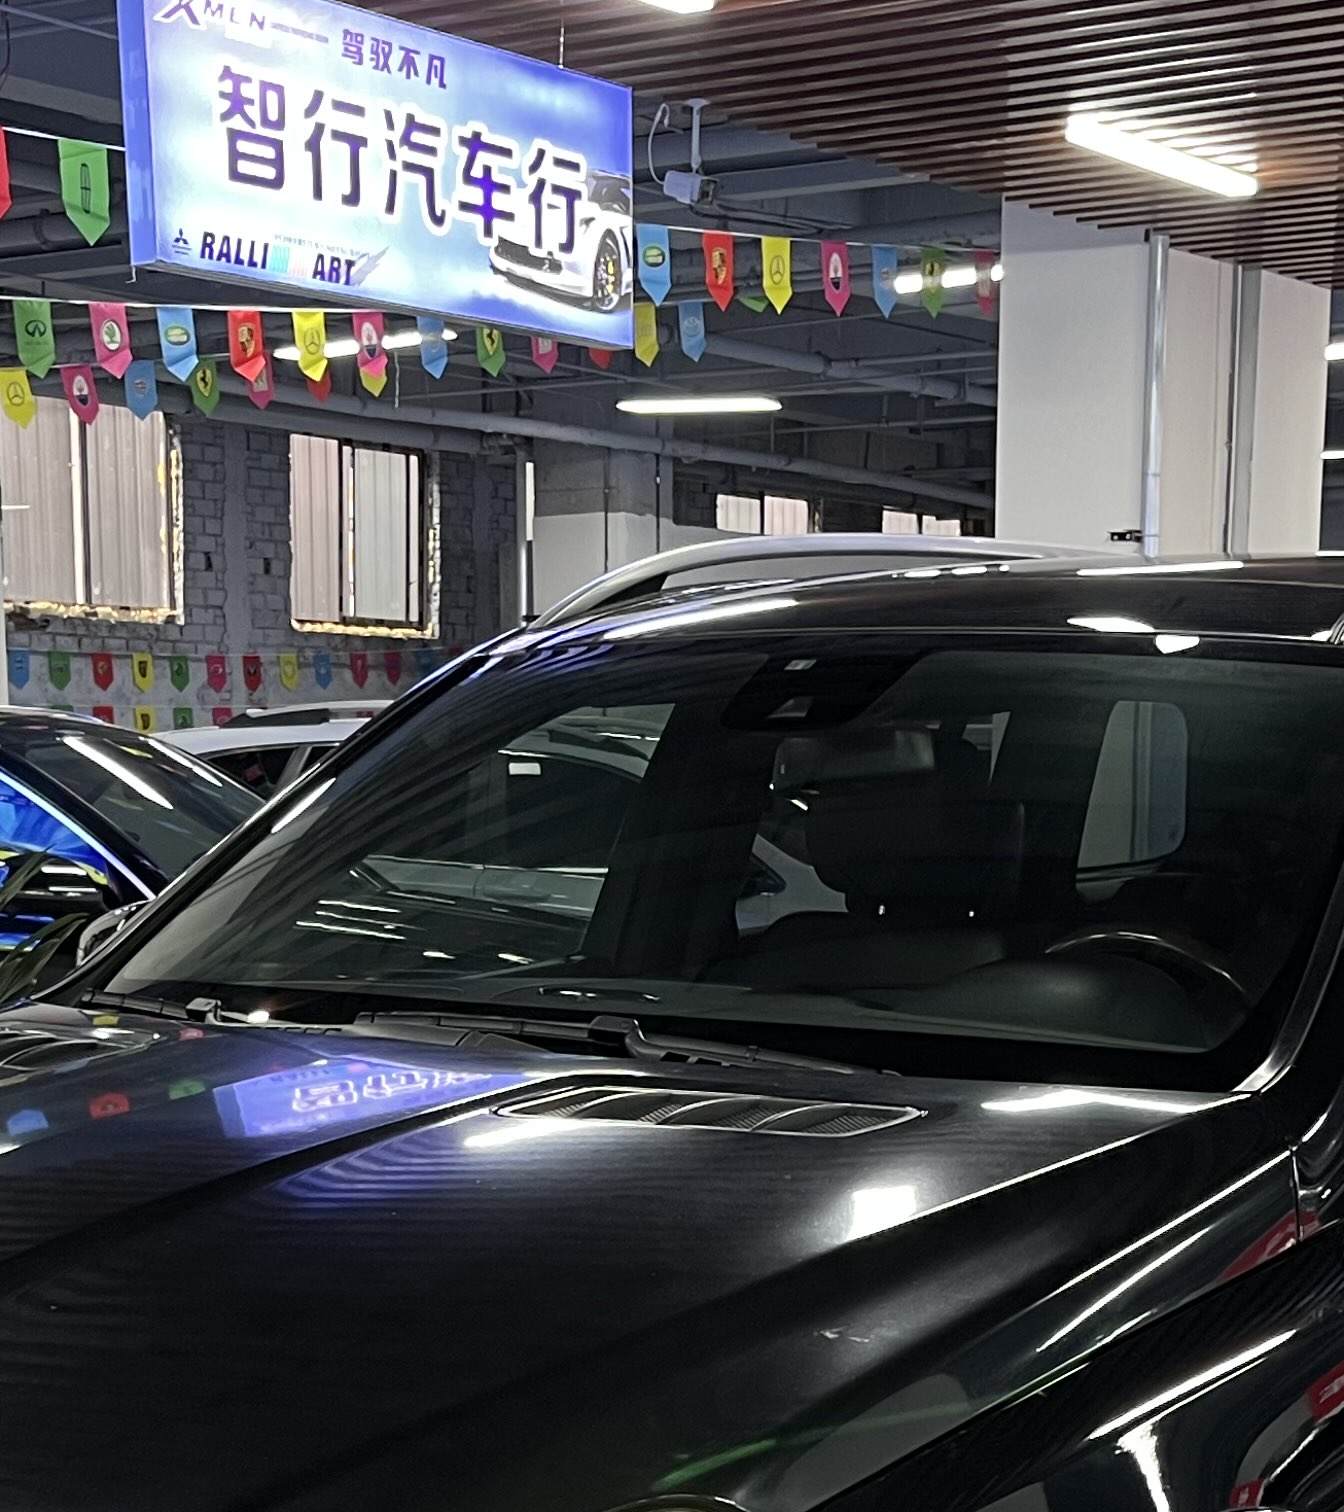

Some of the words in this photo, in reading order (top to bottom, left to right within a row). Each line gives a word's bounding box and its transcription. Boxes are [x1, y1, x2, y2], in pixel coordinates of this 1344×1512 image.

[341, 28, 448, 90] 驾驭不凡
[217, 65, 584, 255] 智行汽车行
[200, 231, 270, 269] RALLI
[312, 252, 357, 286] ART
